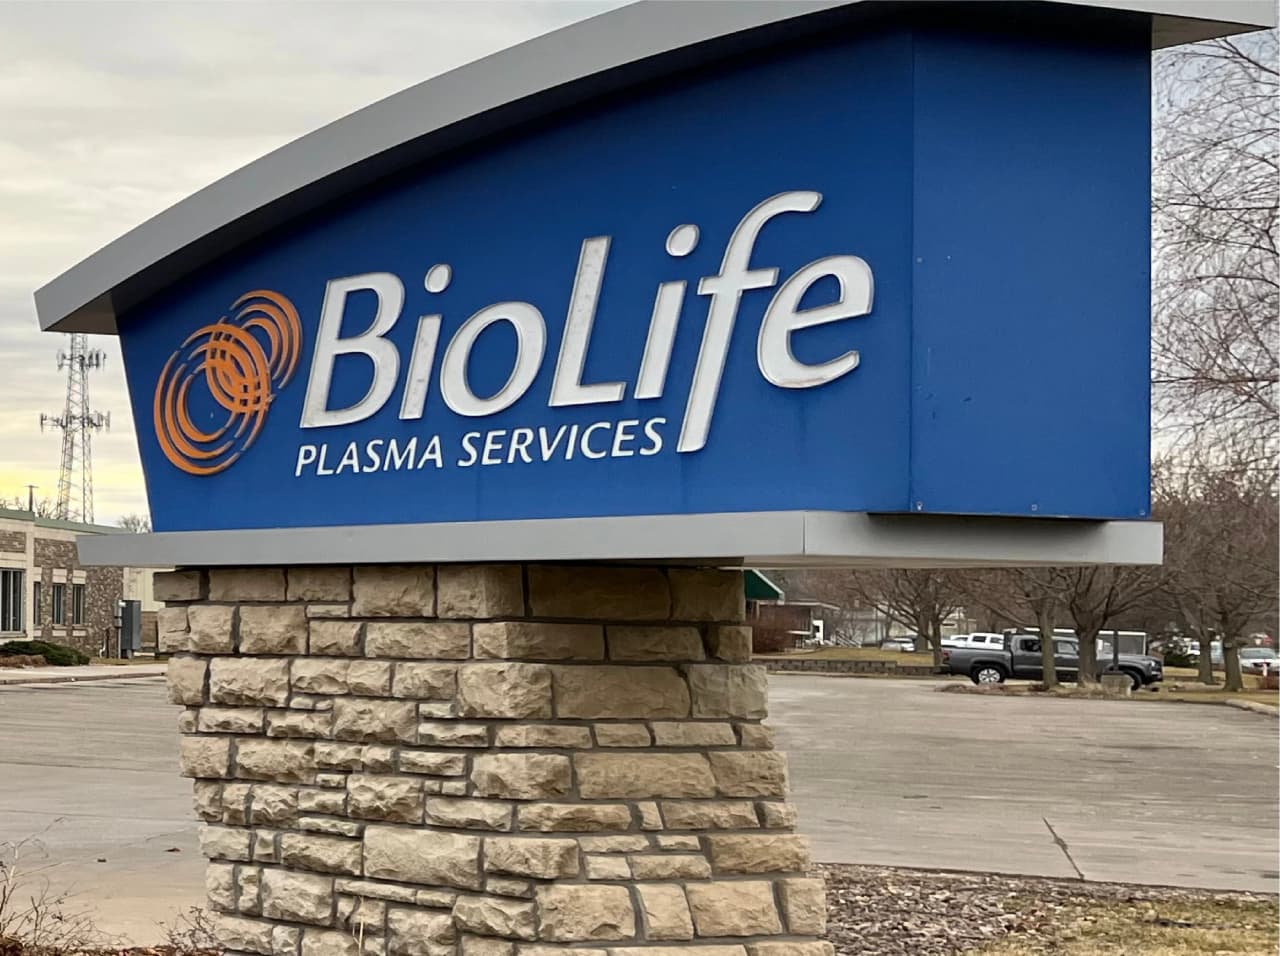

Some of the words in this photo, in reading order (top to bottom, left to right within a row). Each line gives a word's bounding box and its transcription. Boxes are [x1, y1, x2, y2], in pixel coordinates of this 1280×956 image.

[299, 188, 874, 453] BioLife
[296, 433, 443, 478] PLASMA
[457, 418, 663, 469] SERVICES
